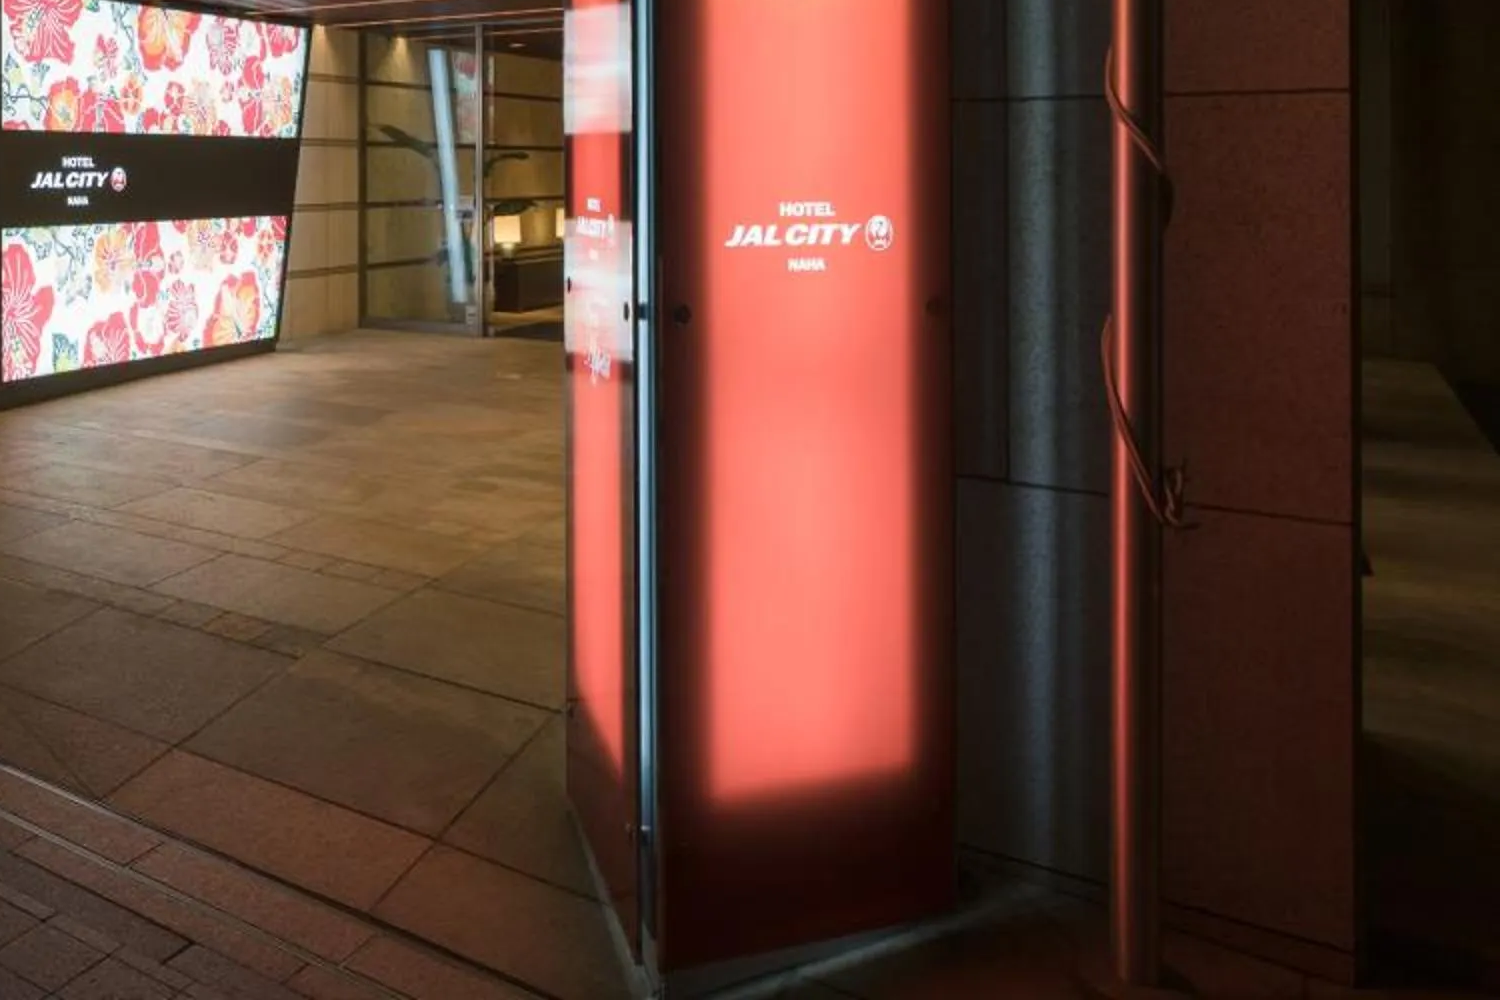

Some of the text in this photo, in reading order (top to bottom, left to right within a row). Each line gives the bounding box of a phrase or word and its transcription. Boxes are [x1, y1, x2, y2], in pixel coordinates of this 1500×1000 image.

[62, 156, 95, 168] HOTEL
[30, 171, 64, 189] JAL
[65, 171, 109, 188] CITY
[779, 202, 835, 217] HOTEL
[724, 224, 781, 247] JAL
[785, 223, 861, 246] CITY
[787, 258, 826, 272] NAHA
